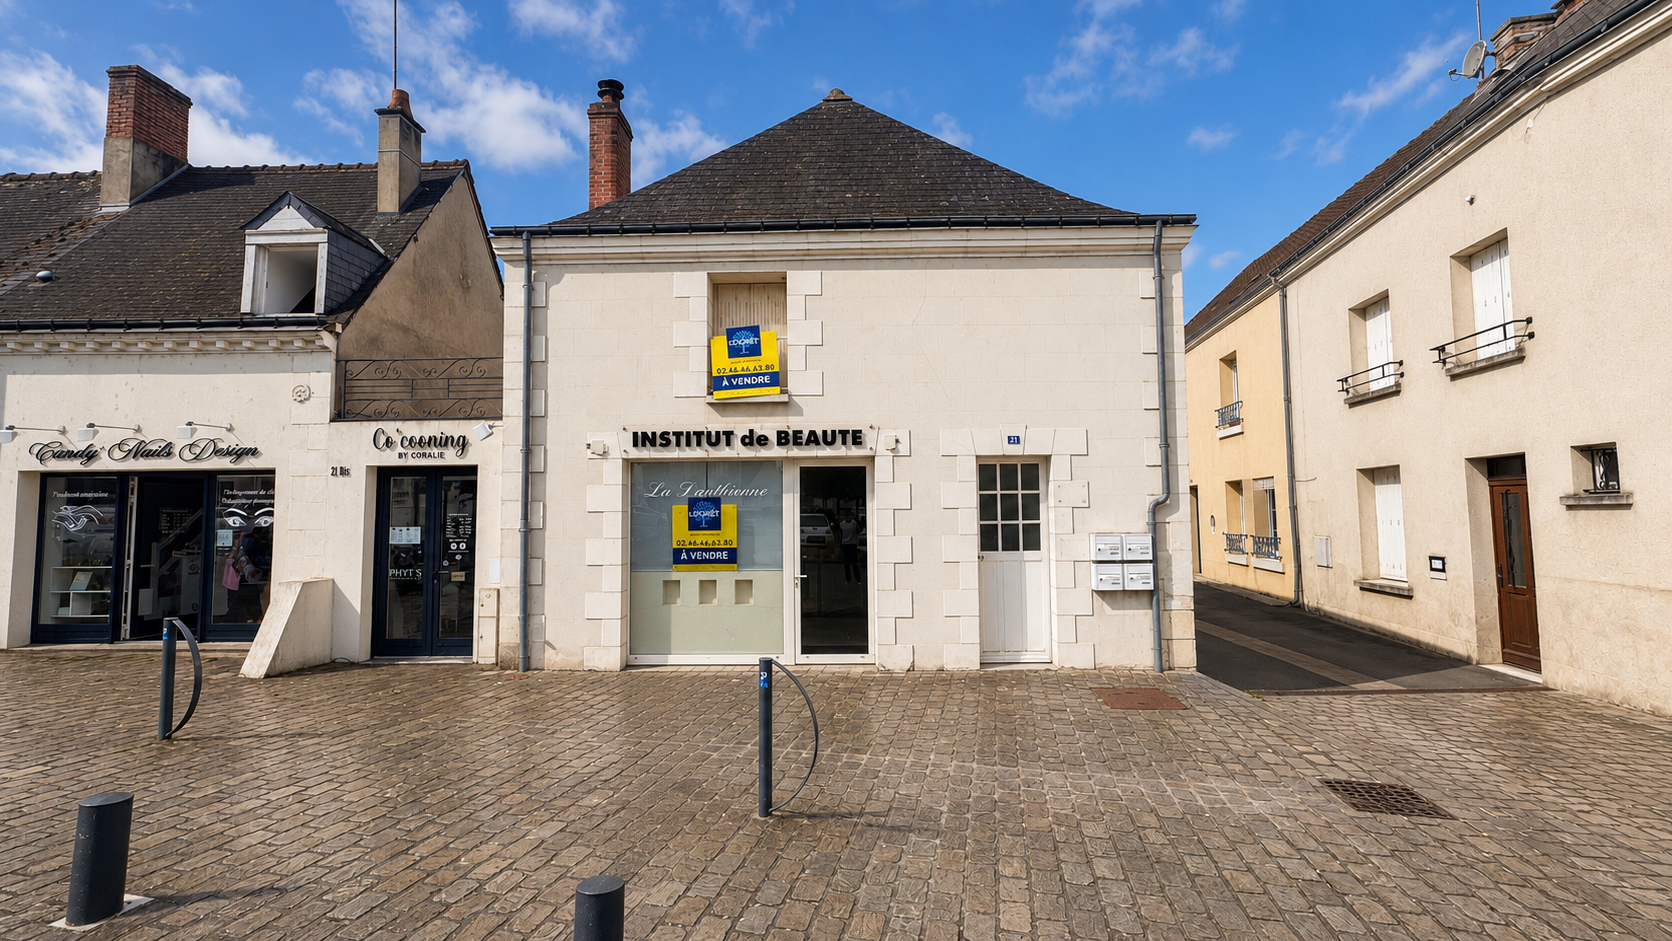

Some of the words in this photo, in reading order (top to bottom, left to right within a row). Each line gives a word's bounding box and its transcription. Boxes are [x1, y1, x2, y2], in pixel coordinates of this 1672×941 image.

[731, 375, 771, 386] VENDRE
[632, 430, 734, 447] INSTITUT
[740, 428, 769, 447] de
[776, 429, 862, 446] BEAUTE
[29, 441, 100, 467] Candy
[108, 437, 173, 461] Nails
[178, 437, 259, 464] Design
[411, 451, 445, 459] CORALIE
[331, 466, 338, 477] 21
[643, 481, 672, 498] La
[690, 551, 729, 560] VENDRE
